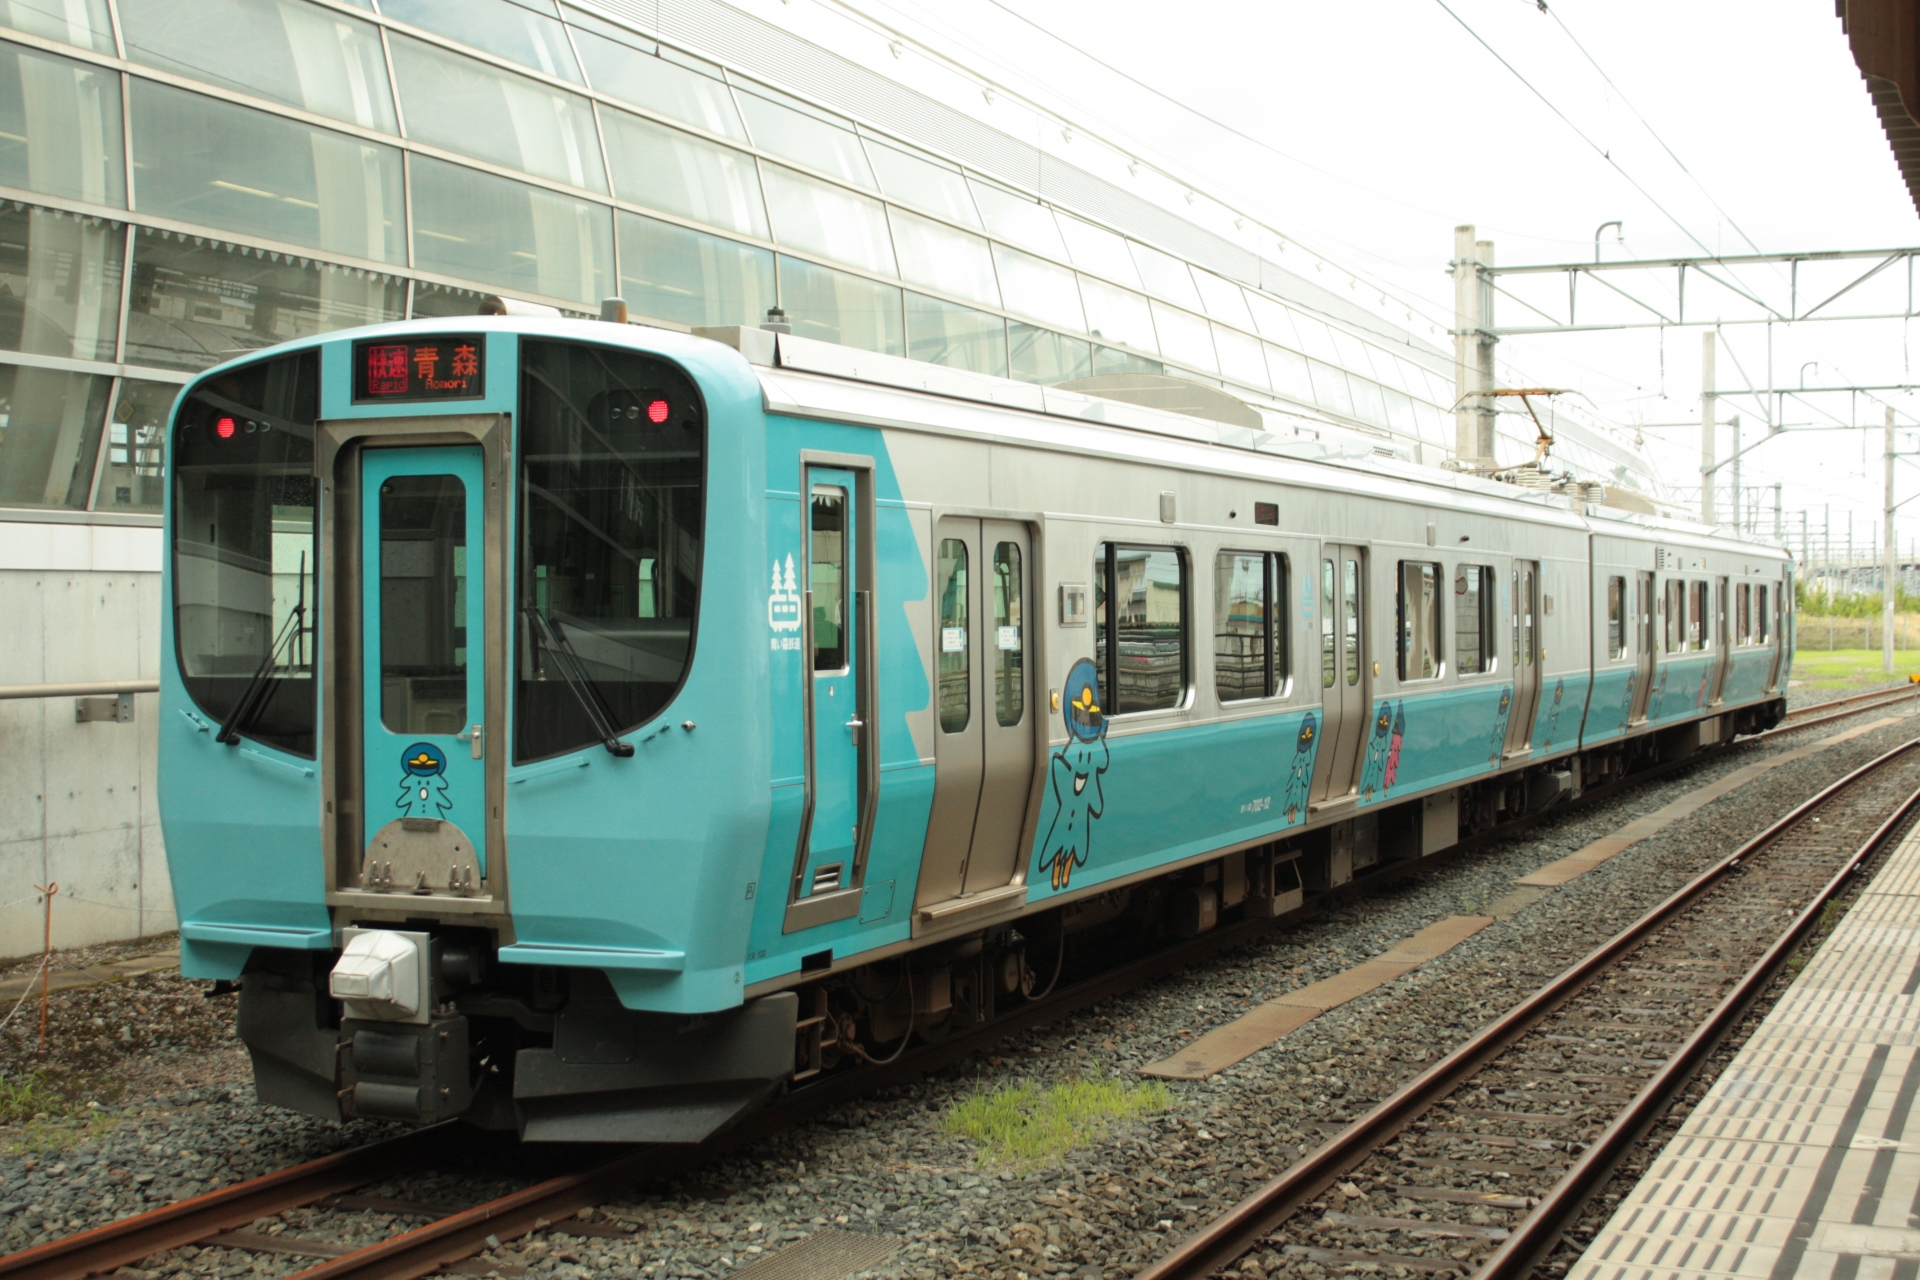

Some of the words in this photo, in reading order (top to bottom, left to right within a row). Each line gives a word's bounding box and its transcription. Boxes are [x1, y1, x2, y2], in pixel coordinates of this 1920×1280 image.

[370, 349, 406, 378] 快速
[372, 380, 406, 391] Rapid
[425, 378, 467, 390] Aomori
